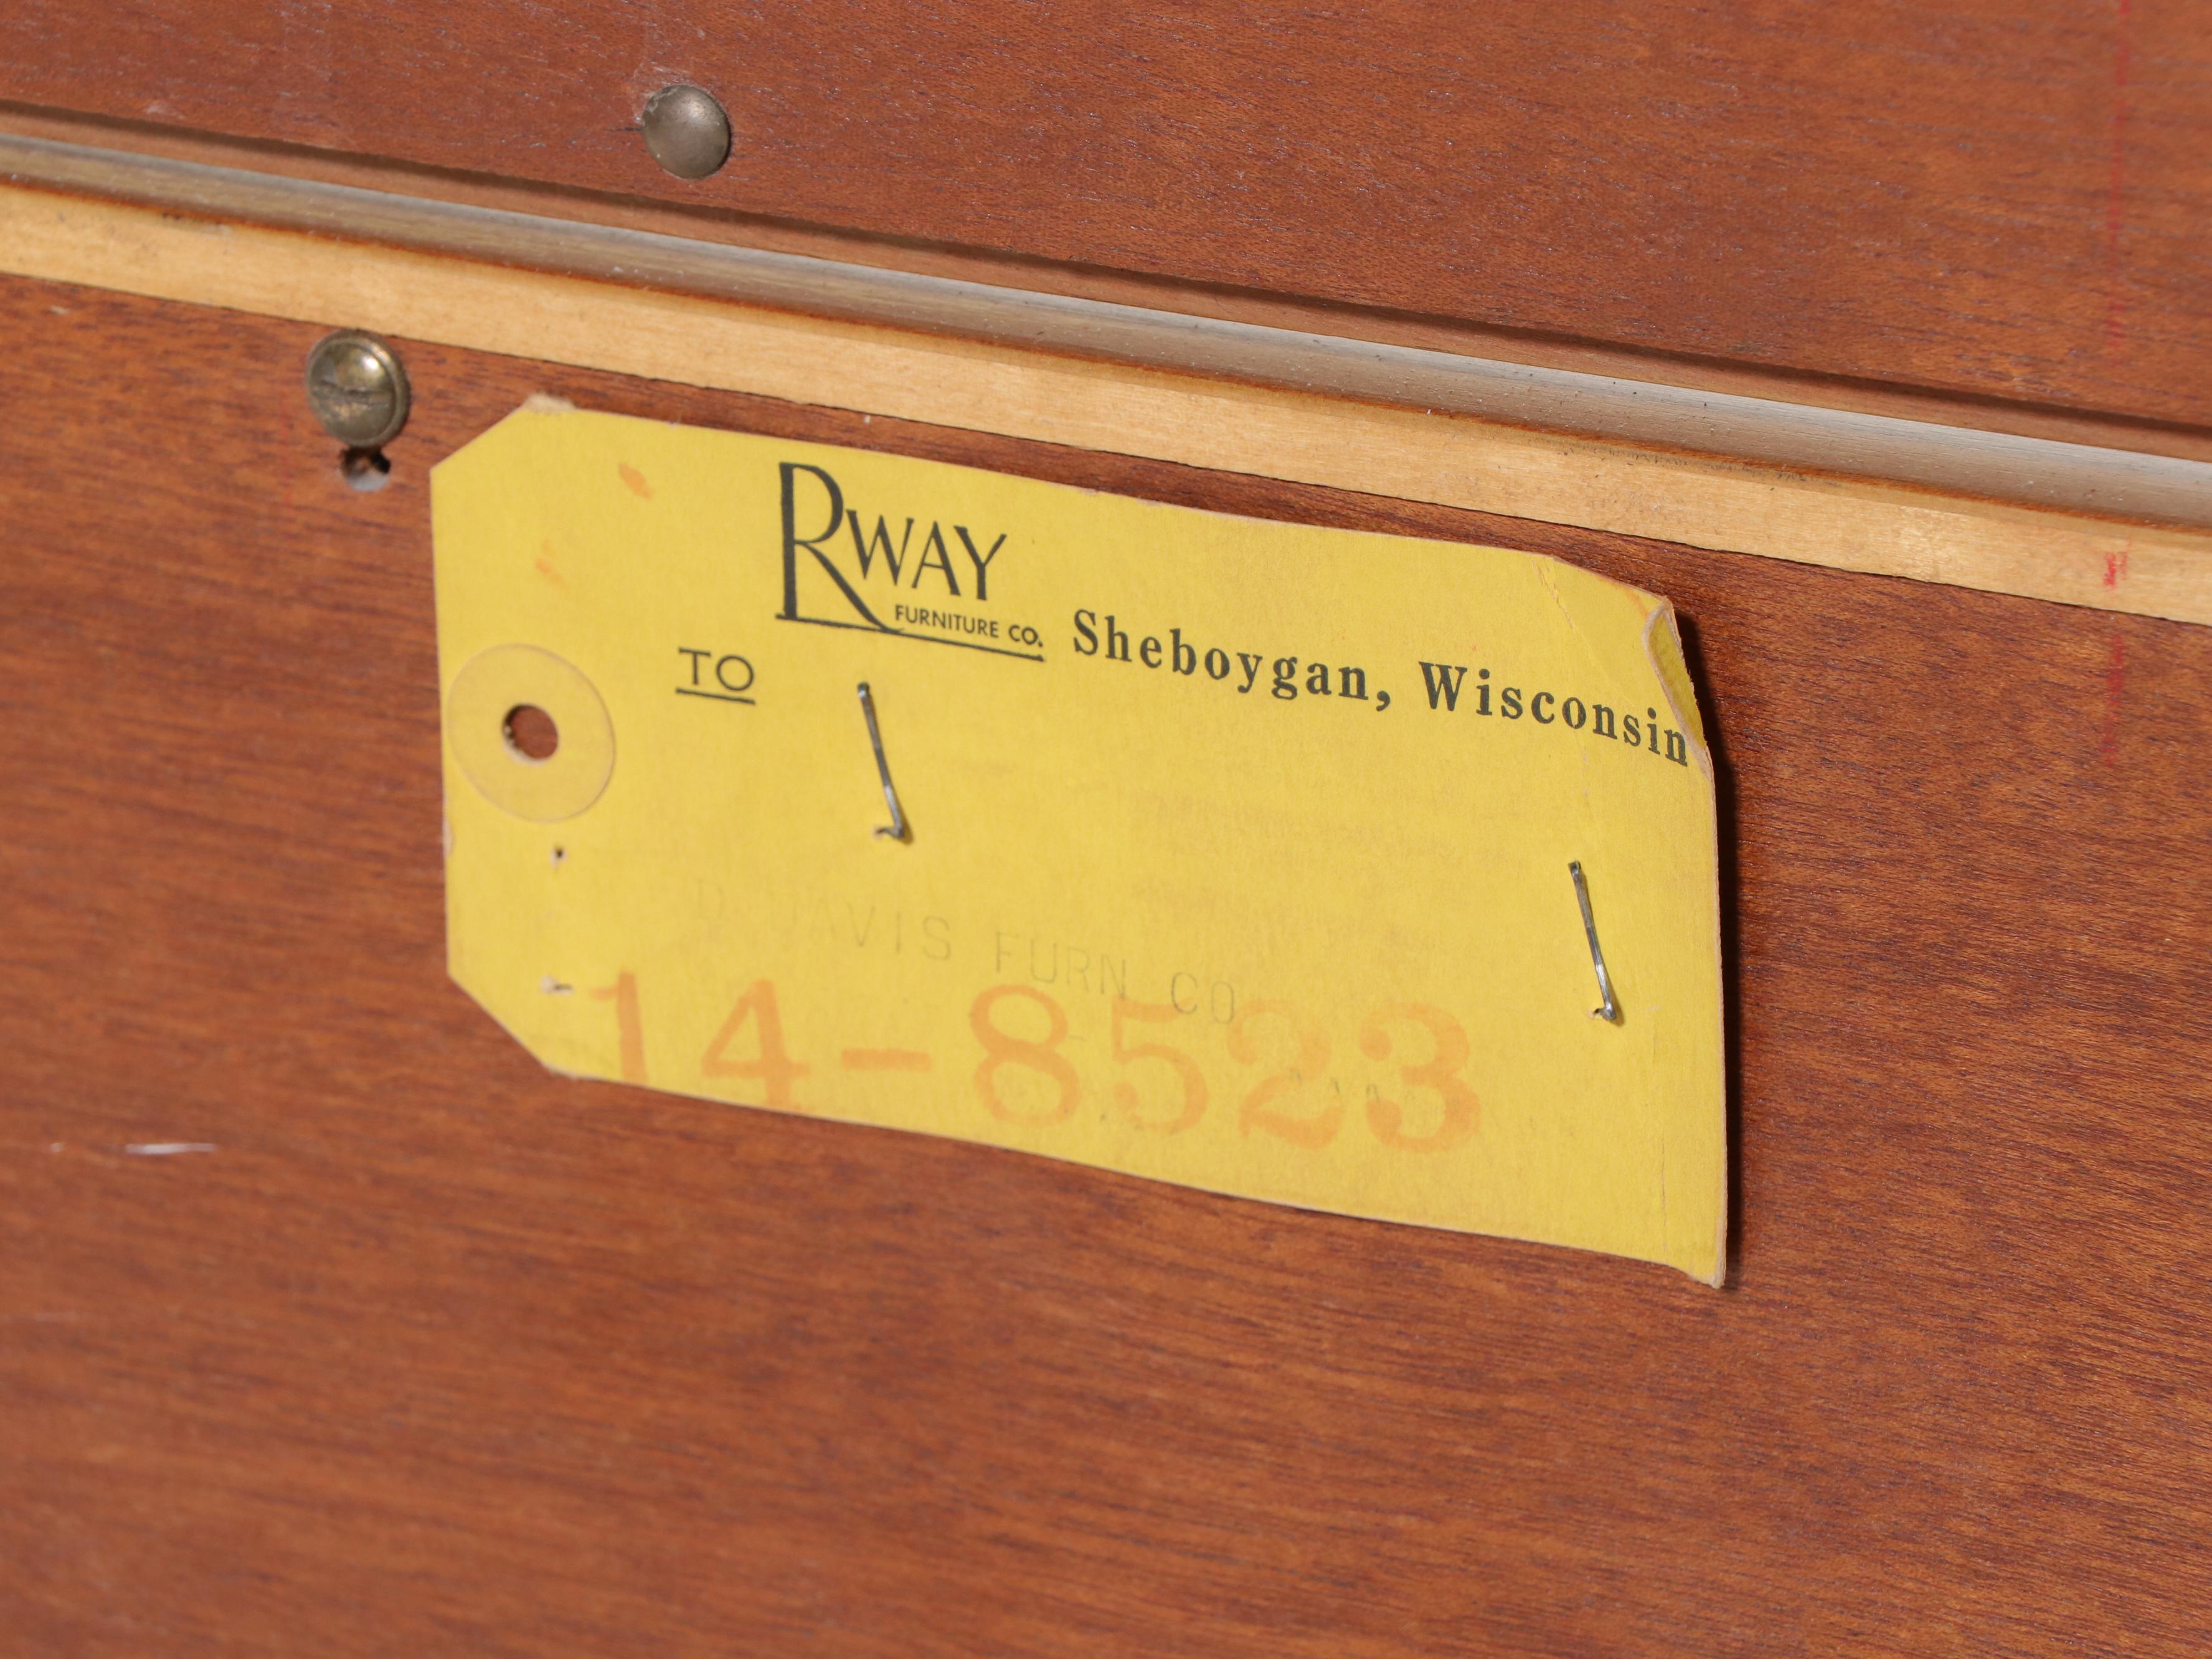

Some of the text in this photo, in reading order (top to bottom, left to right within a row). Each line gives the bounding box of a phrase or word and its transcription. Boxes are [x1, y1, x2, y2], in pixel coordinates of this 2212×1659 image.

[775, 461, 1007, 635] RWAY
[678, 647, 755, 692] TO
[895, 603, 1044, 648] FURNITURE CO.
[1073, 608, 1689, 767] Sheboygan, Wisconsin
[995, 930, 1128, 1000] FURN
[1169, 971, 1237, 1026] CO
[588, 969, 1482, 1153] 14-8523
